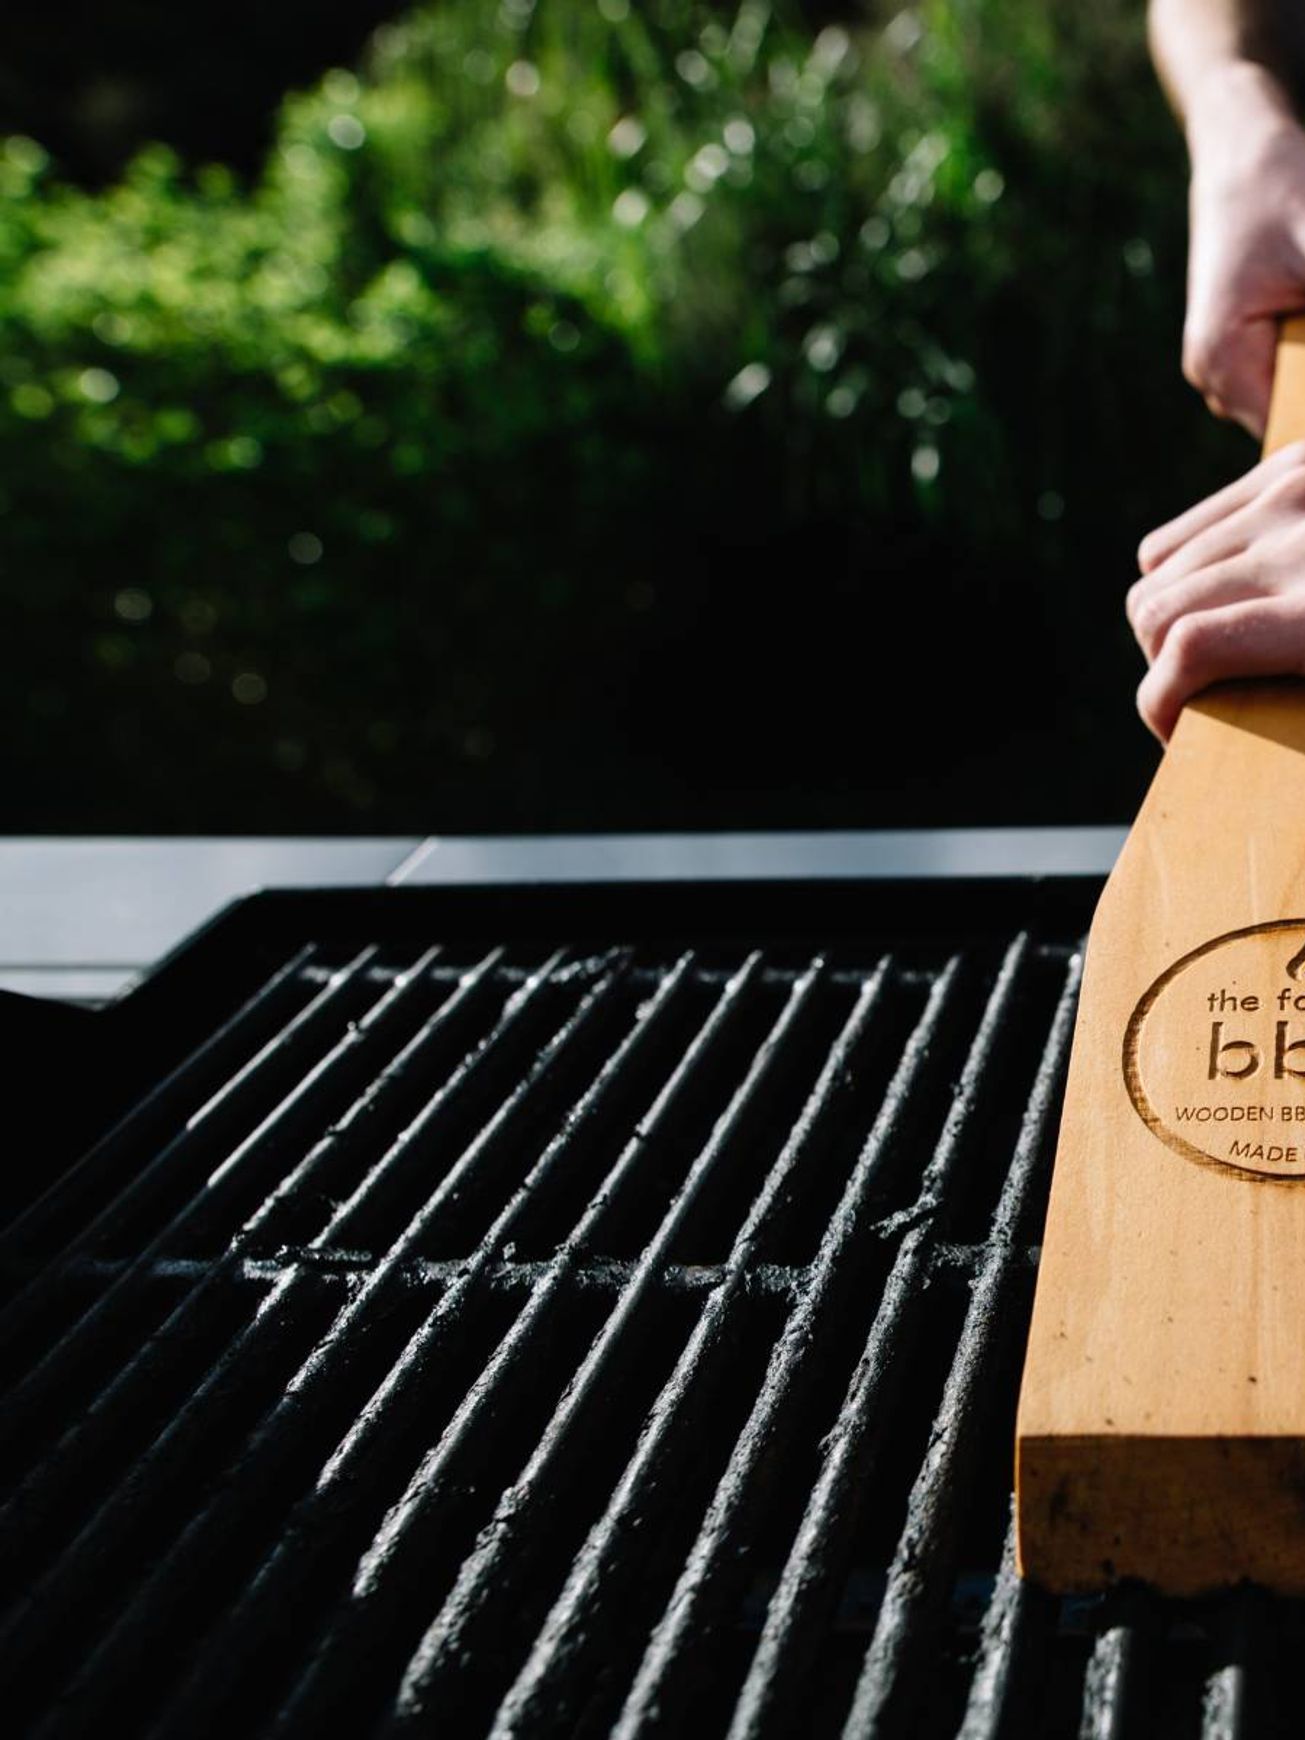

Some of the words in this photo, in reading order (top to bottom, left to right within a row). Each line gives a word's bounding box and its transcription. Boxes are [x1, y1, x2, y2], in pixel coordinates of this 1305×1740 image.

[1207, 988, 1260, 1013] the
[1175, 1106, 1274, 1122] WOODEN
[1229, 1140, 1297, 1163] MADE
